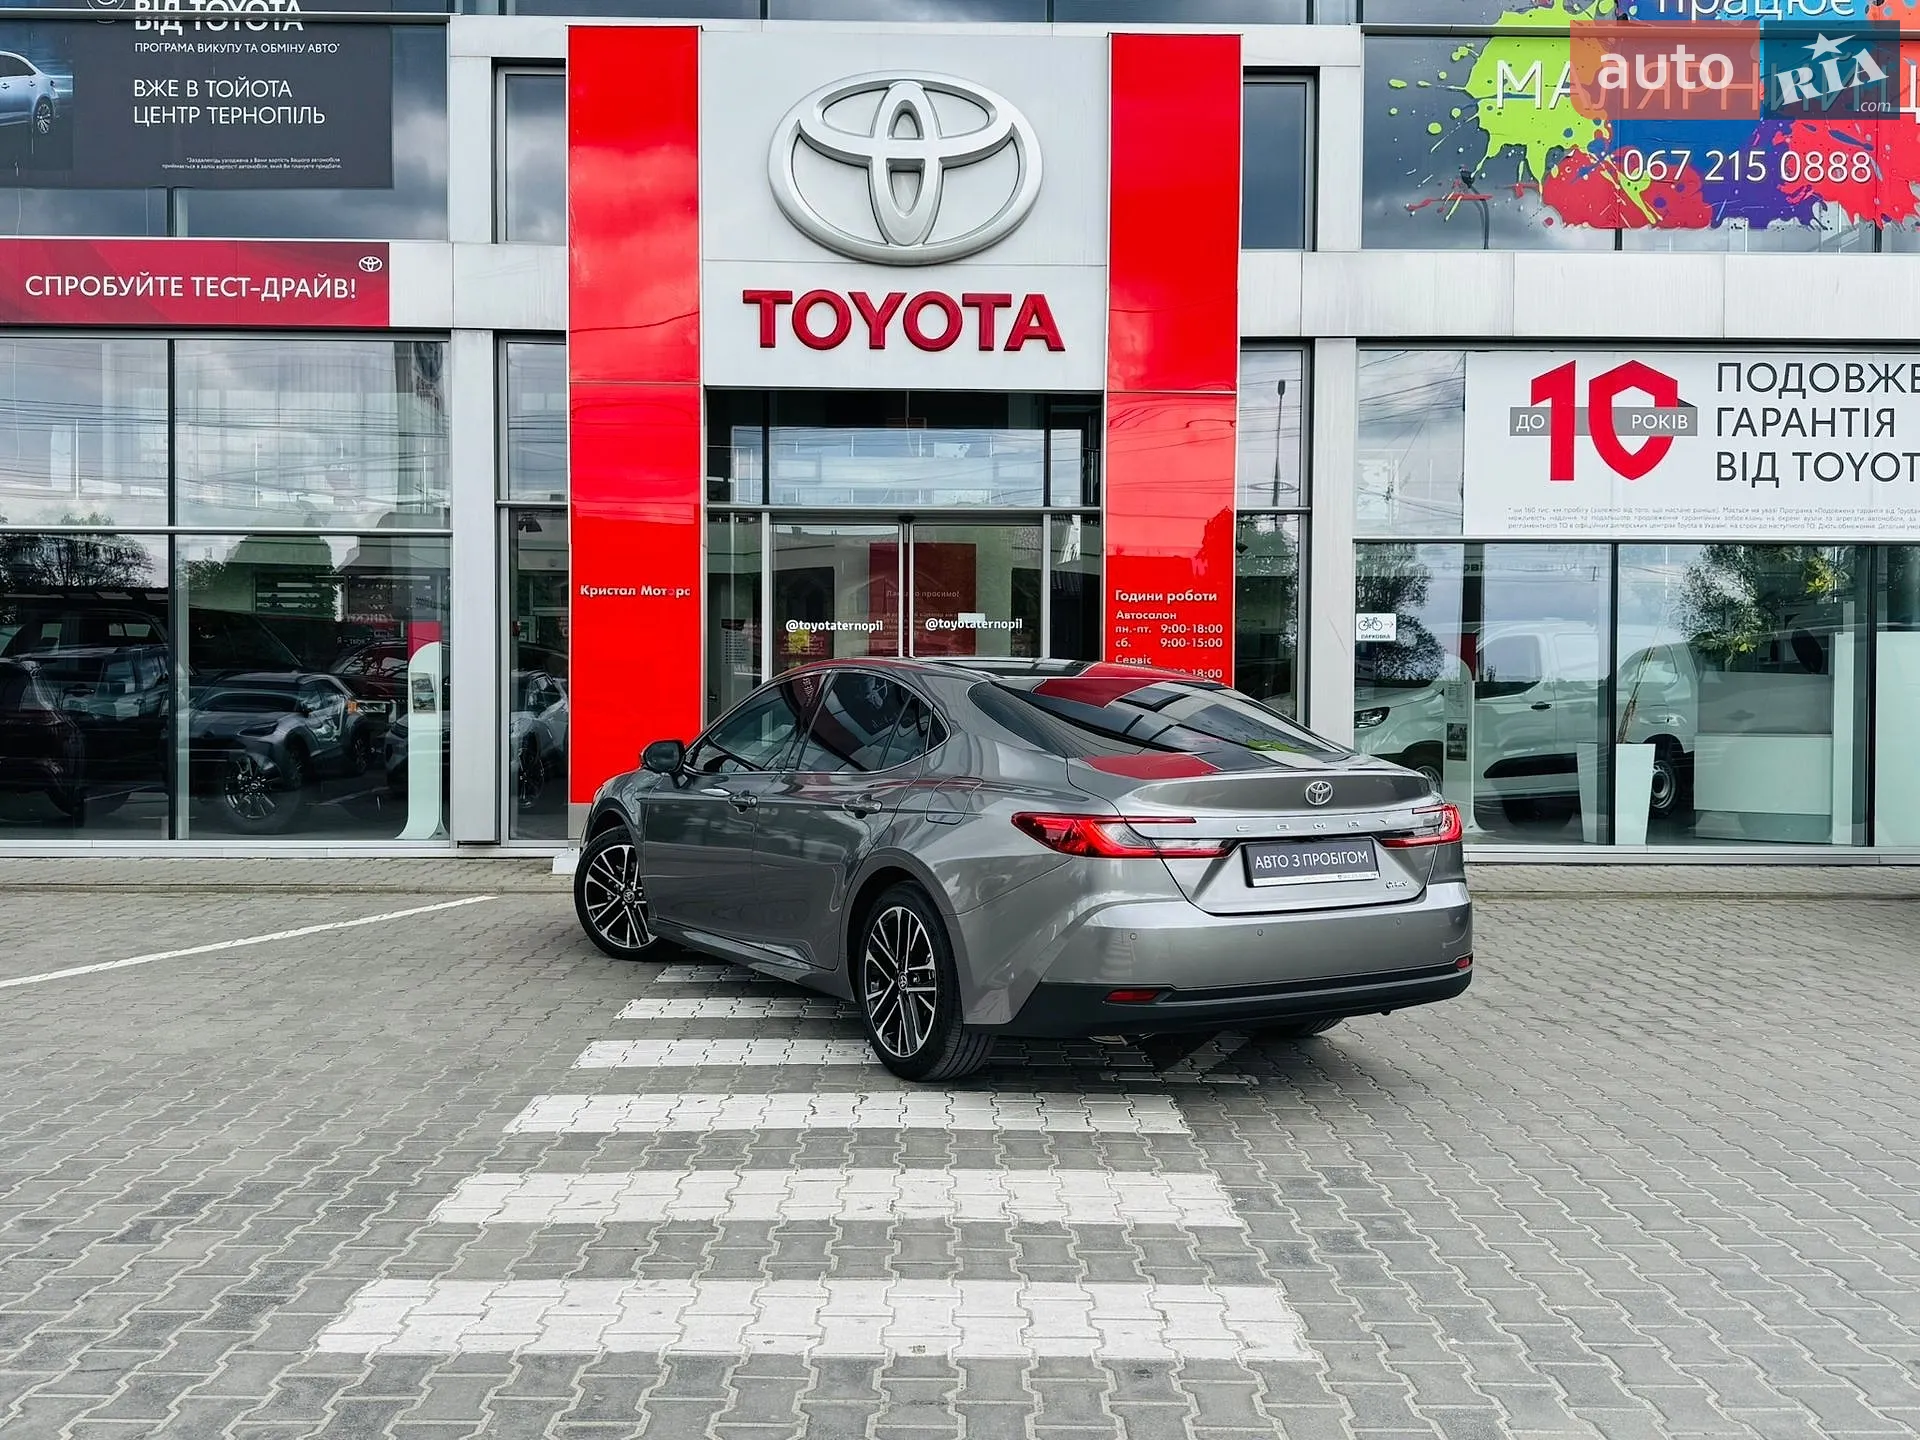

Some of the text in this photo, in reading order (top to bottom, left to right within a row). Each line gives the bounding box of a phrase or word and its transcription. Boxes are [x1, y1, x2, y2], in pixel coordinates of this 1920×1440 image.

[135, 43, 195, 53] ПРОГРАМА
[197, 43, 242, 53] ВИКУПУ
[244, 43, 258, 53] ТА
[260, 43, 305, 53] ОБМІНУ
[134, 75, 293, 98] ВЖЕ В ТОЙОТА
[134, 106, 326, 127] ЦЕНТР ТЕРНОПІЛЬ
[1622, 150, 1873, 183] 067 215 0888
[25, 272, 356, 301] СПРОБУЙТЕ ТЕСТ-ДРАЙВ!
[742, 289, 1066, 352] TOYOTA
[1516, 414, 1545, 432] ДО
[1632, 414, 1688, 430] РОКІВ
[1717, 407, 1895, 438] ГАРАНТІЯ
[1717, 451, 1780, 489] ВІД
[580, 585, 636, 597] Кристал
[1115, 589, 1217, 604] Години роботи
[1116, 610, 1177, 619] Автосалон
[785, 619, 883, 636] @toyotaternopil
[925, 617, 1023, 634] @toyotaternopil
[1115, 638, 1131, 647] сб.
[1115, 654, 1152, 664] Сервіс
[1255, 851, 1369, 870] АВТО З ПРОБІГОМ
